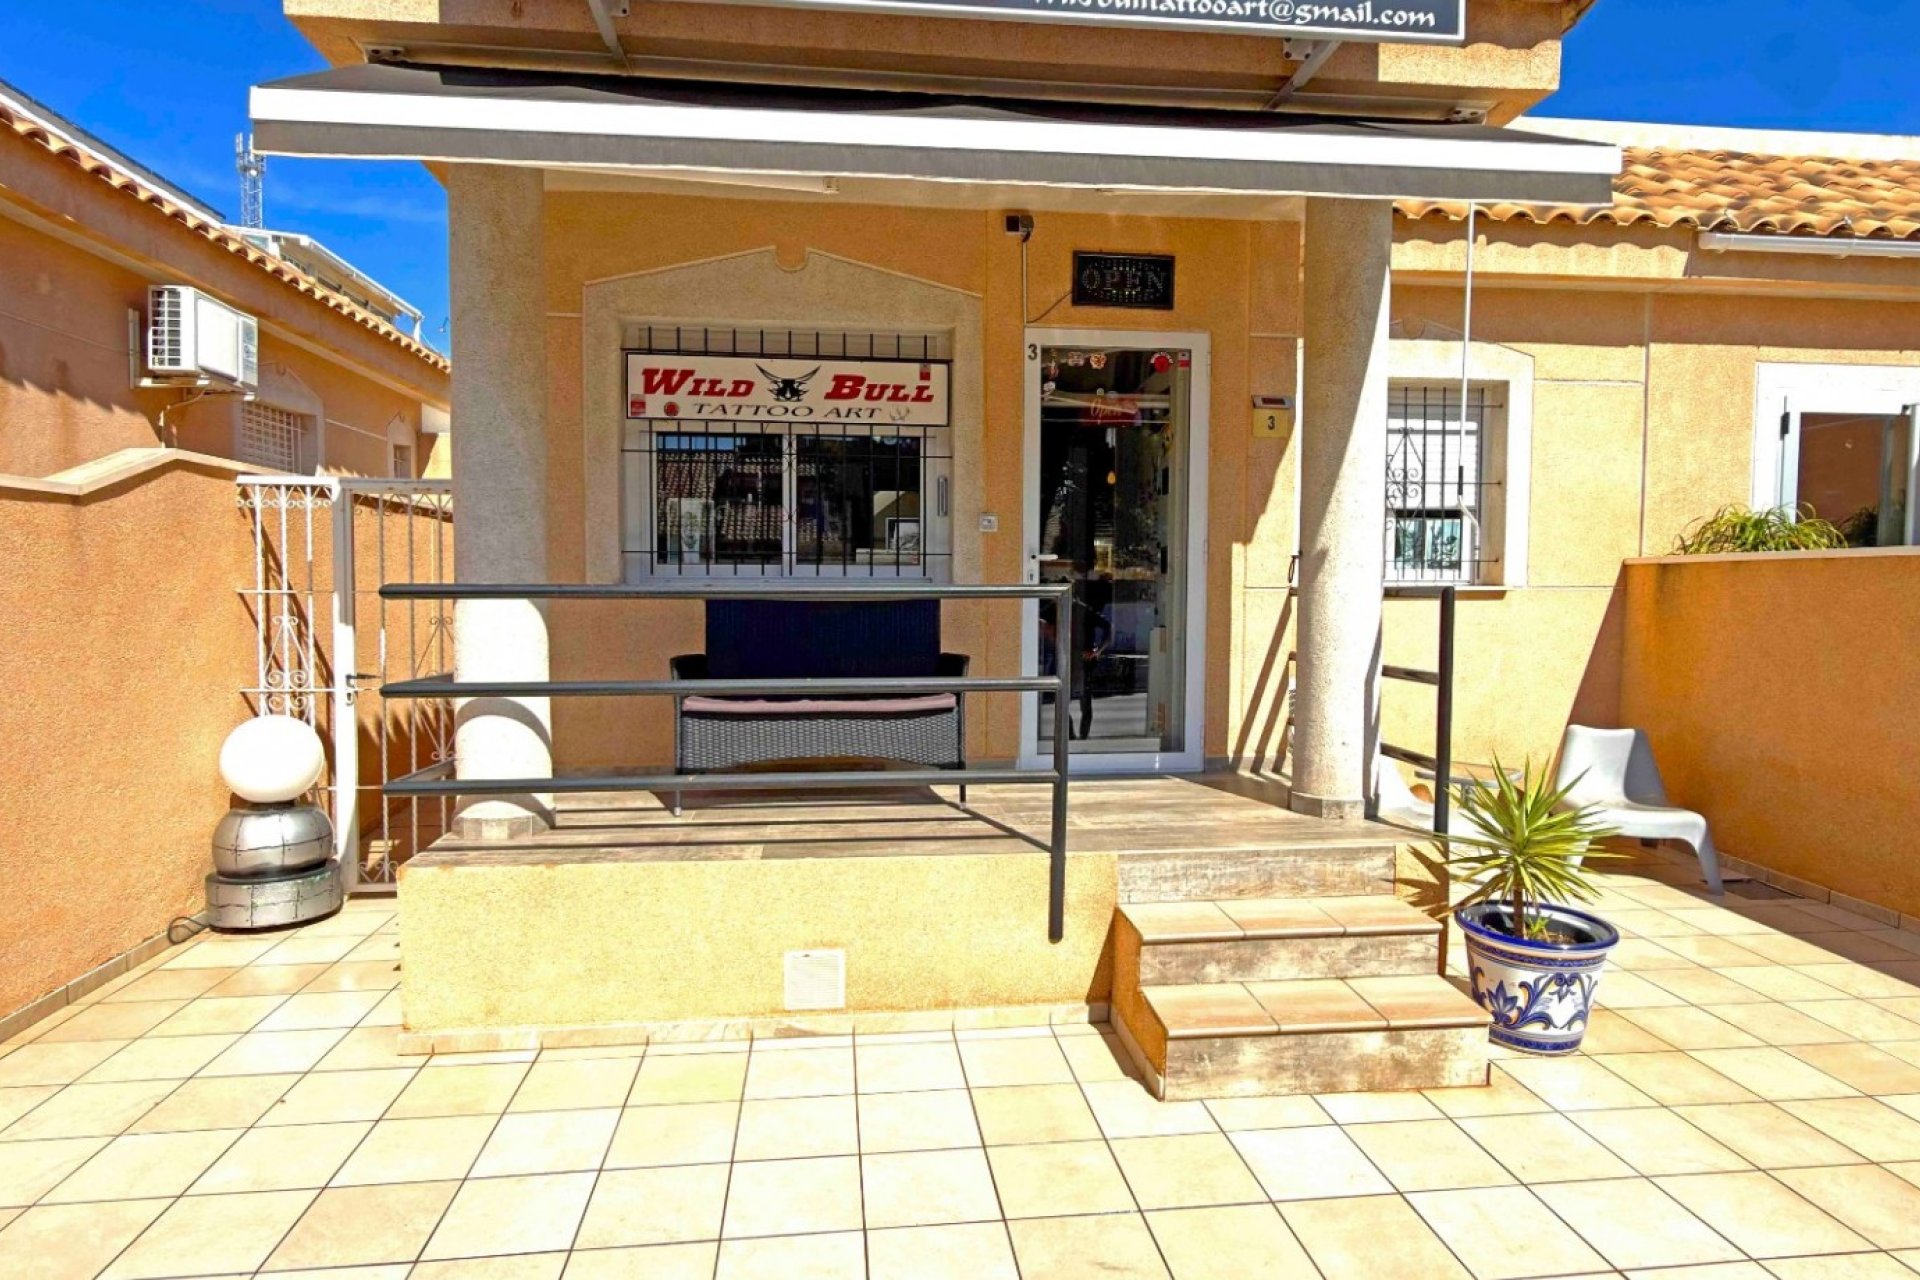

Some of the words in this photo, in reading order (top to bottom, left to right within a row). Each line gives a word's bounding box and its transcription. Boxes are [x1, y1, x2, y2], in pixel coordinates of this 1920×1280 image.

[1034, 0, 1437, 27] utattooart@gmail.com
[1081, 267, 1168, 293] OPEN
[1028, 344, 1038, 361] 3
[641, 368, 755, 397] WILD
[824, 374, 935, 403] BULL
[694, 402, 814, 418] TATTOO
[824, 406, 882, 419] ART
[1267, 415, 1276, 430] 3
